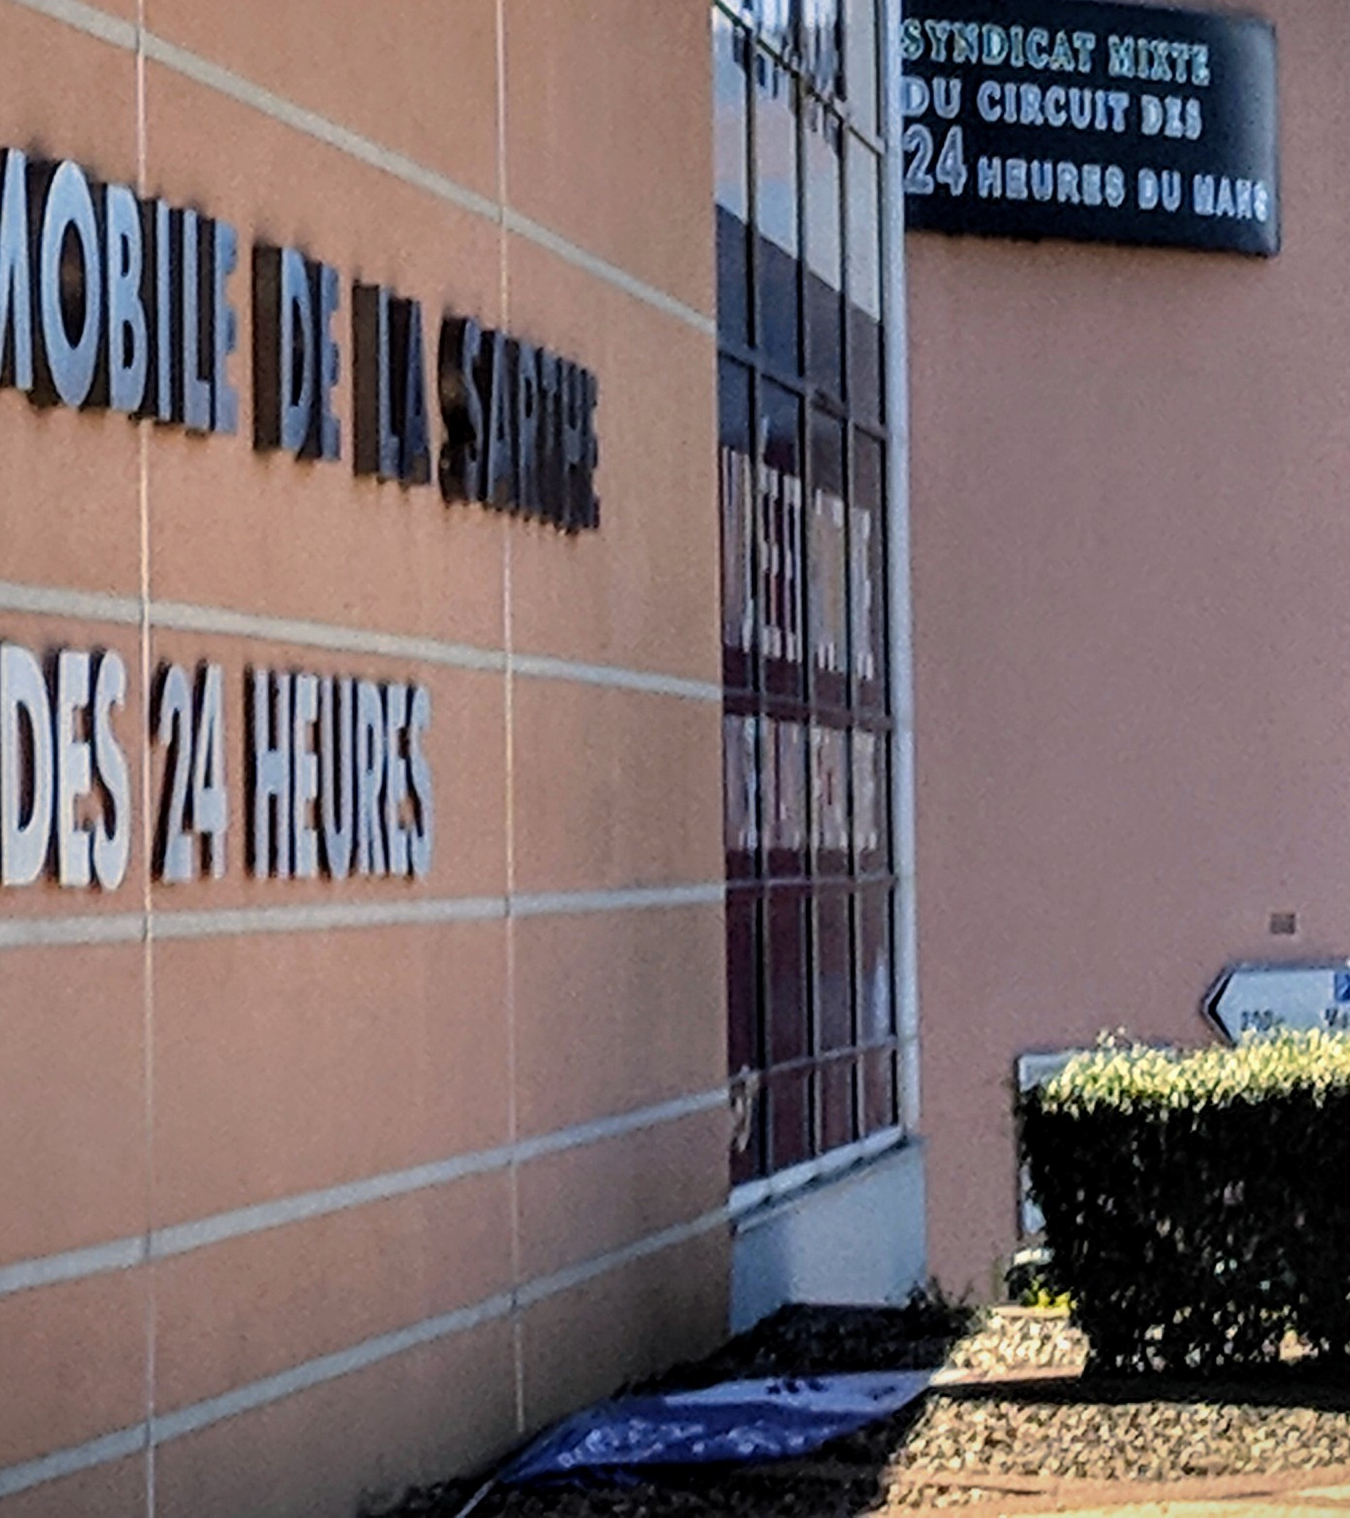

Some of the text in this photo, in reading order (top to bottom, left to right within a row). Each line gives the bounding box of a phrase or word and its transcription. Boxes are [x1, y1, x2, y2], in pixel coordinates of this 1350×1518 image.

[901, 18, 1096, 74] SYNDICAT
[902, 76, 1203, 141] DU CIRCUIT DES
[904, 124, 967, 196] 24
[977, 155, 1126, 209] HEURES
[1137, 167, 1181, 212] DU
[265, 246, 341, 461] DE
[365, 286, 431, 484] LA
[157, 662, 228, 885] 24
[251, 666, 435, 882] HEURES
